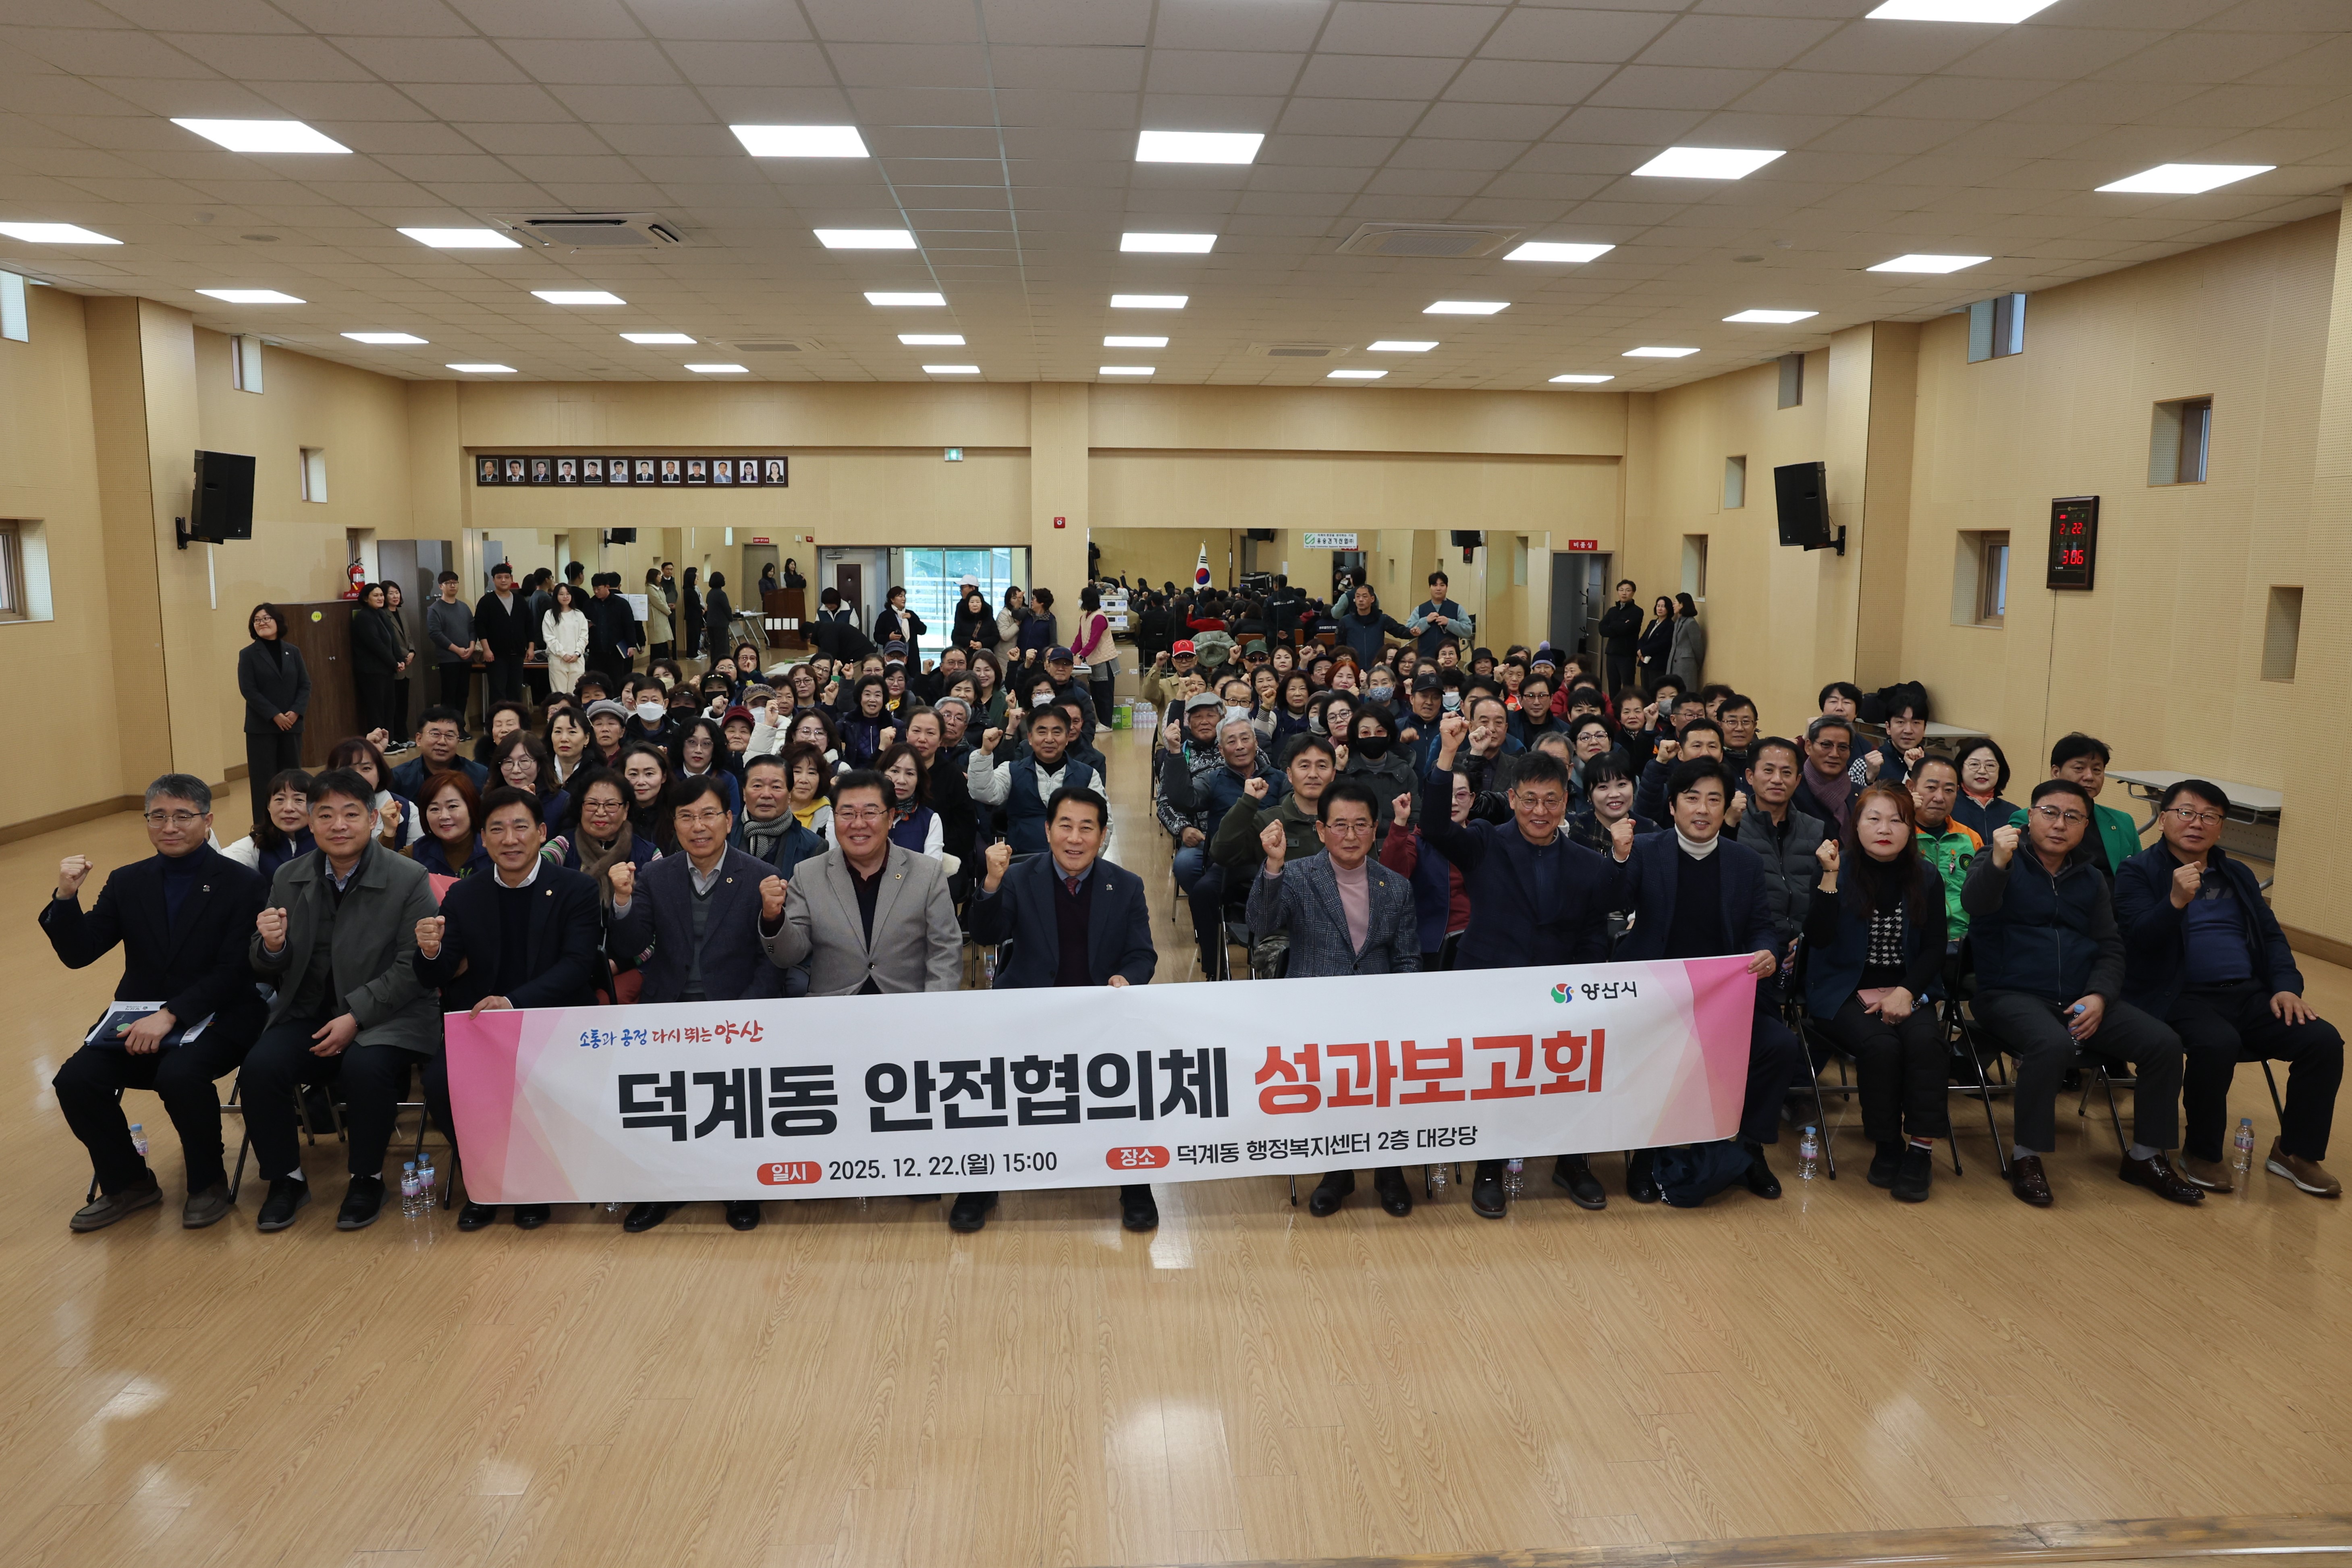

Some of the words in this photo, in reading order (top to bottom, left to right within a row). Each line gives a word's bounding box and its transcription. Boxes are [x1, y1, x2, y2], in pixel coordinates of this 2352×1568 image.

[2072, 523, 2082, 534] 22
[1581, 981, 1638, 1001] 양산시
[580, 1029, 617, 1049] 소통과
[621, 1029, 647, 1047] 공정
[652, 1028, 681, 1044] 다시
[685, 1027, 712, 1044] 뛰는
[714, 1020, 764, 1044] 양산
[618, 1064, 839, 1142] 덕계동
[864, 1047, 1229, 1133] 안전협의체
[1255, 1028, 1605, 1115] 성과보고회
[1177, 1142, 1240, 1165] 덕계동
[1246, 1132, 1371, 1161] 행정복지센터
[1377, 1129, 1410, 1151] 2층
[1416, 1124, 1479, 1148] 대강당
[828, 1159, 886, 1180] 2025.
[893, 1157, 922, 1178] 12.
[928, 1152, 996, 1177] 22.(월)
[1003, 1151, 1058, 1172] 15:00
[1120, 1148, 1155, 1167] 장소
[771, 1163, 807, 1182] 일시
